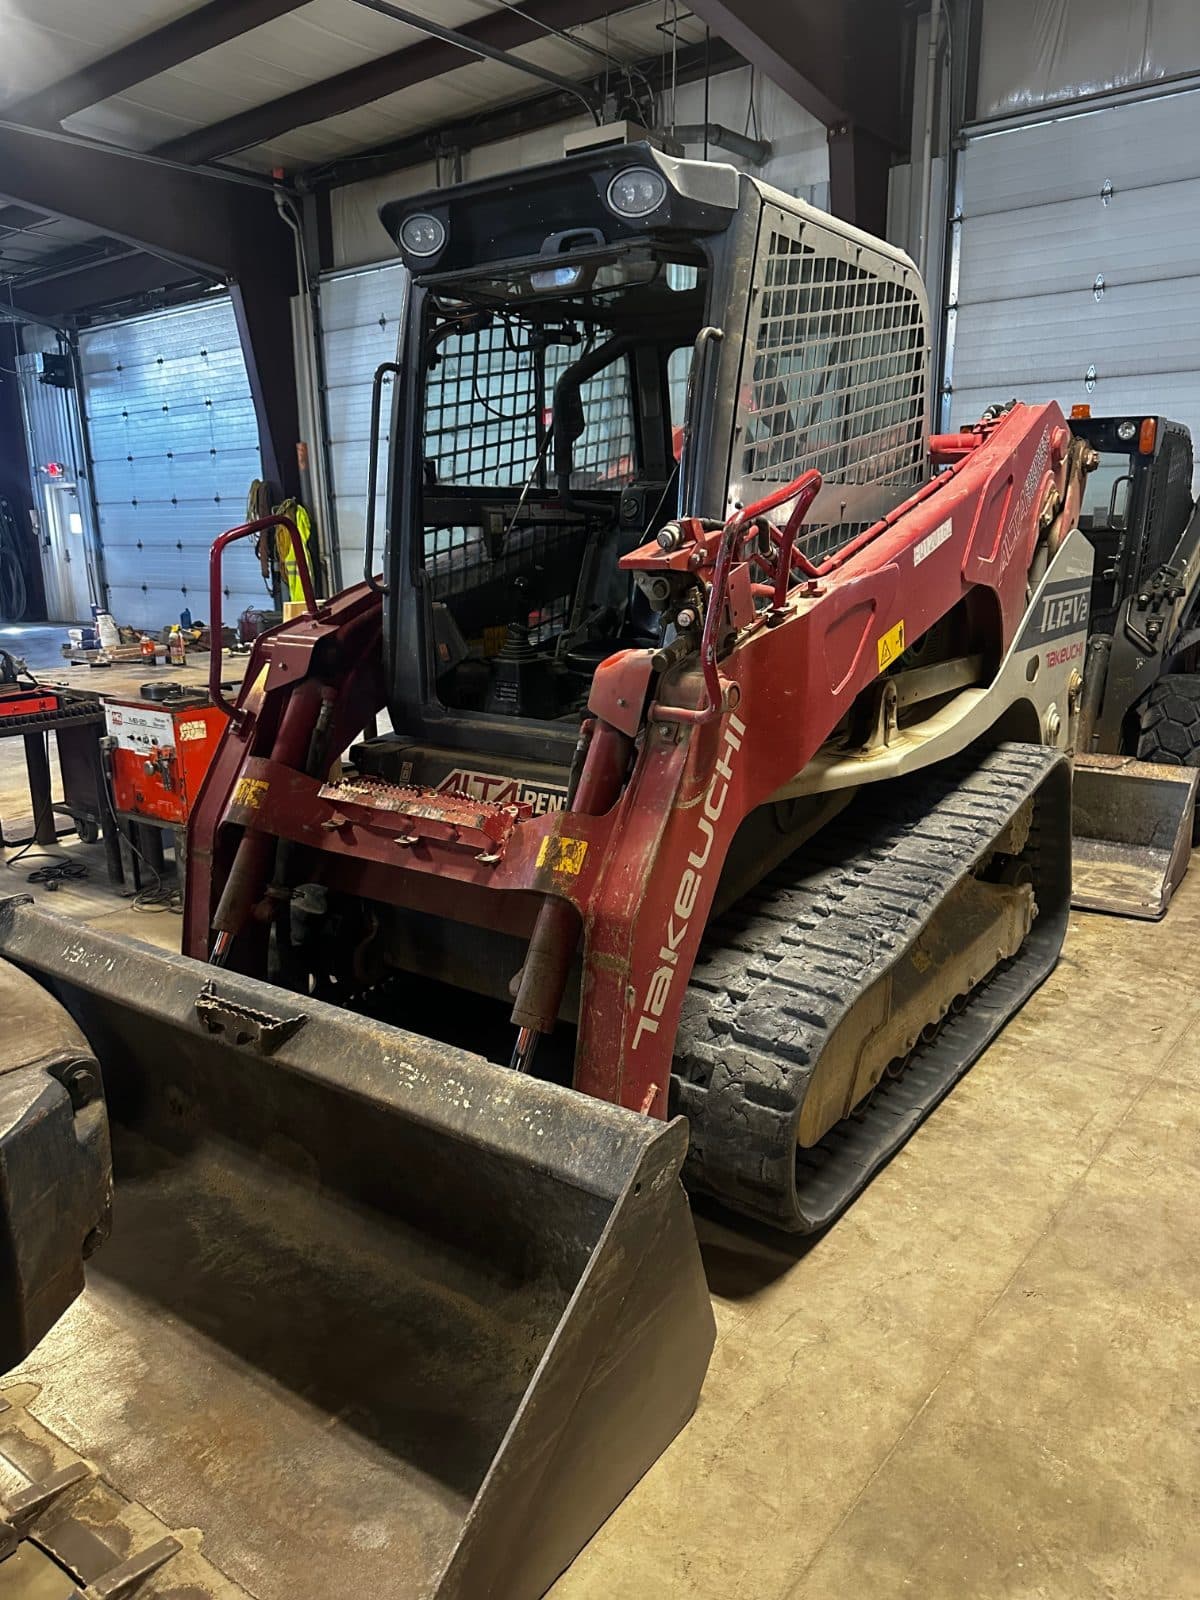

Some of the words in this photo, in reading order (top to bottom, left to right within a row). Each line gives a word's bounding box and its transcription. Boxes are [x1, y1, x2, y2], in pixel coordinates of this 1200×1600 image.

[437, 772, 520, 803] ALTA
[524, 790, 569, 814] REN
[631, 713, 747, 1051] TAKEUCHI
